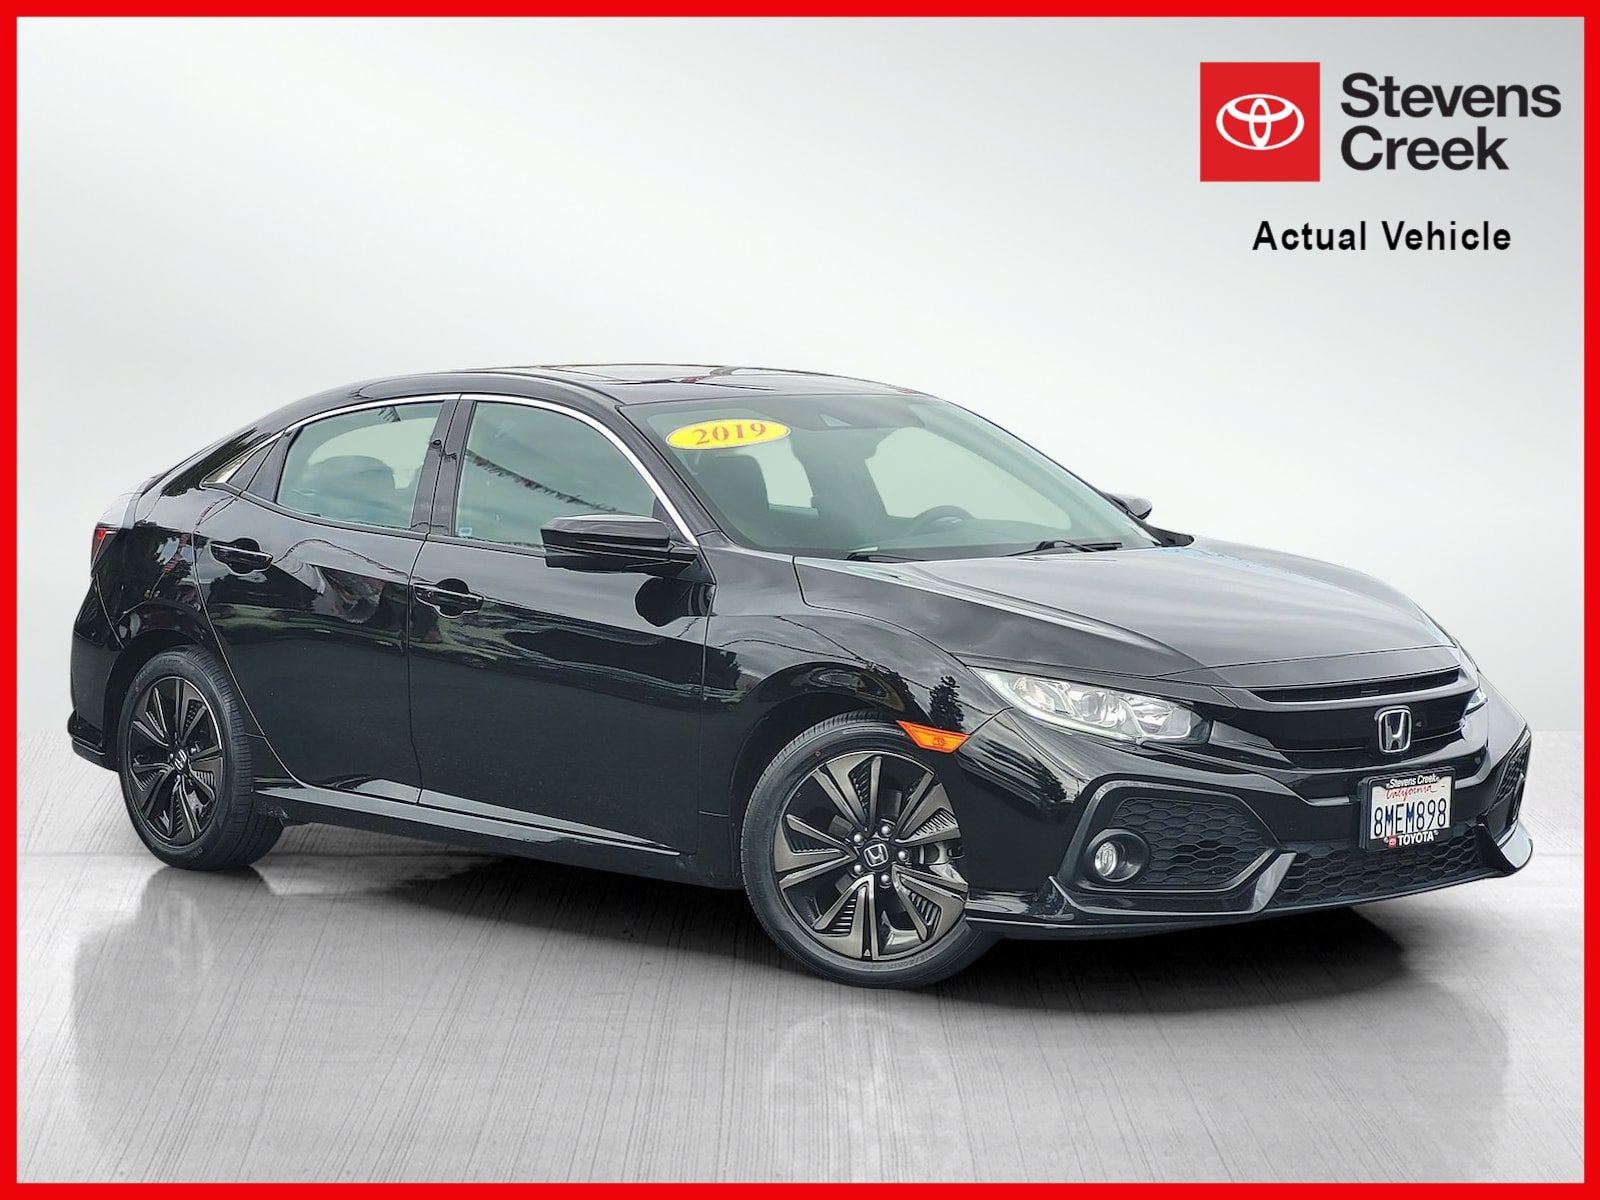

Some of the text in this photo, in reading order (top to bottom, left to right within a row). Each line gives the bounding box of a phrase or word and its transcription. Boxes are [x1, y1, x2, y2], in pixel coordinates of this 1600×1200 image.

[693, 423, 766, 445] 2019
[1389, 773, 1436, 788] Stevens Creek
[1385, 785, 1437, 801] California
[1373, 797, 1447, 837] 8MEM898
[1398, 831, 1434, 846] TOYOTA
